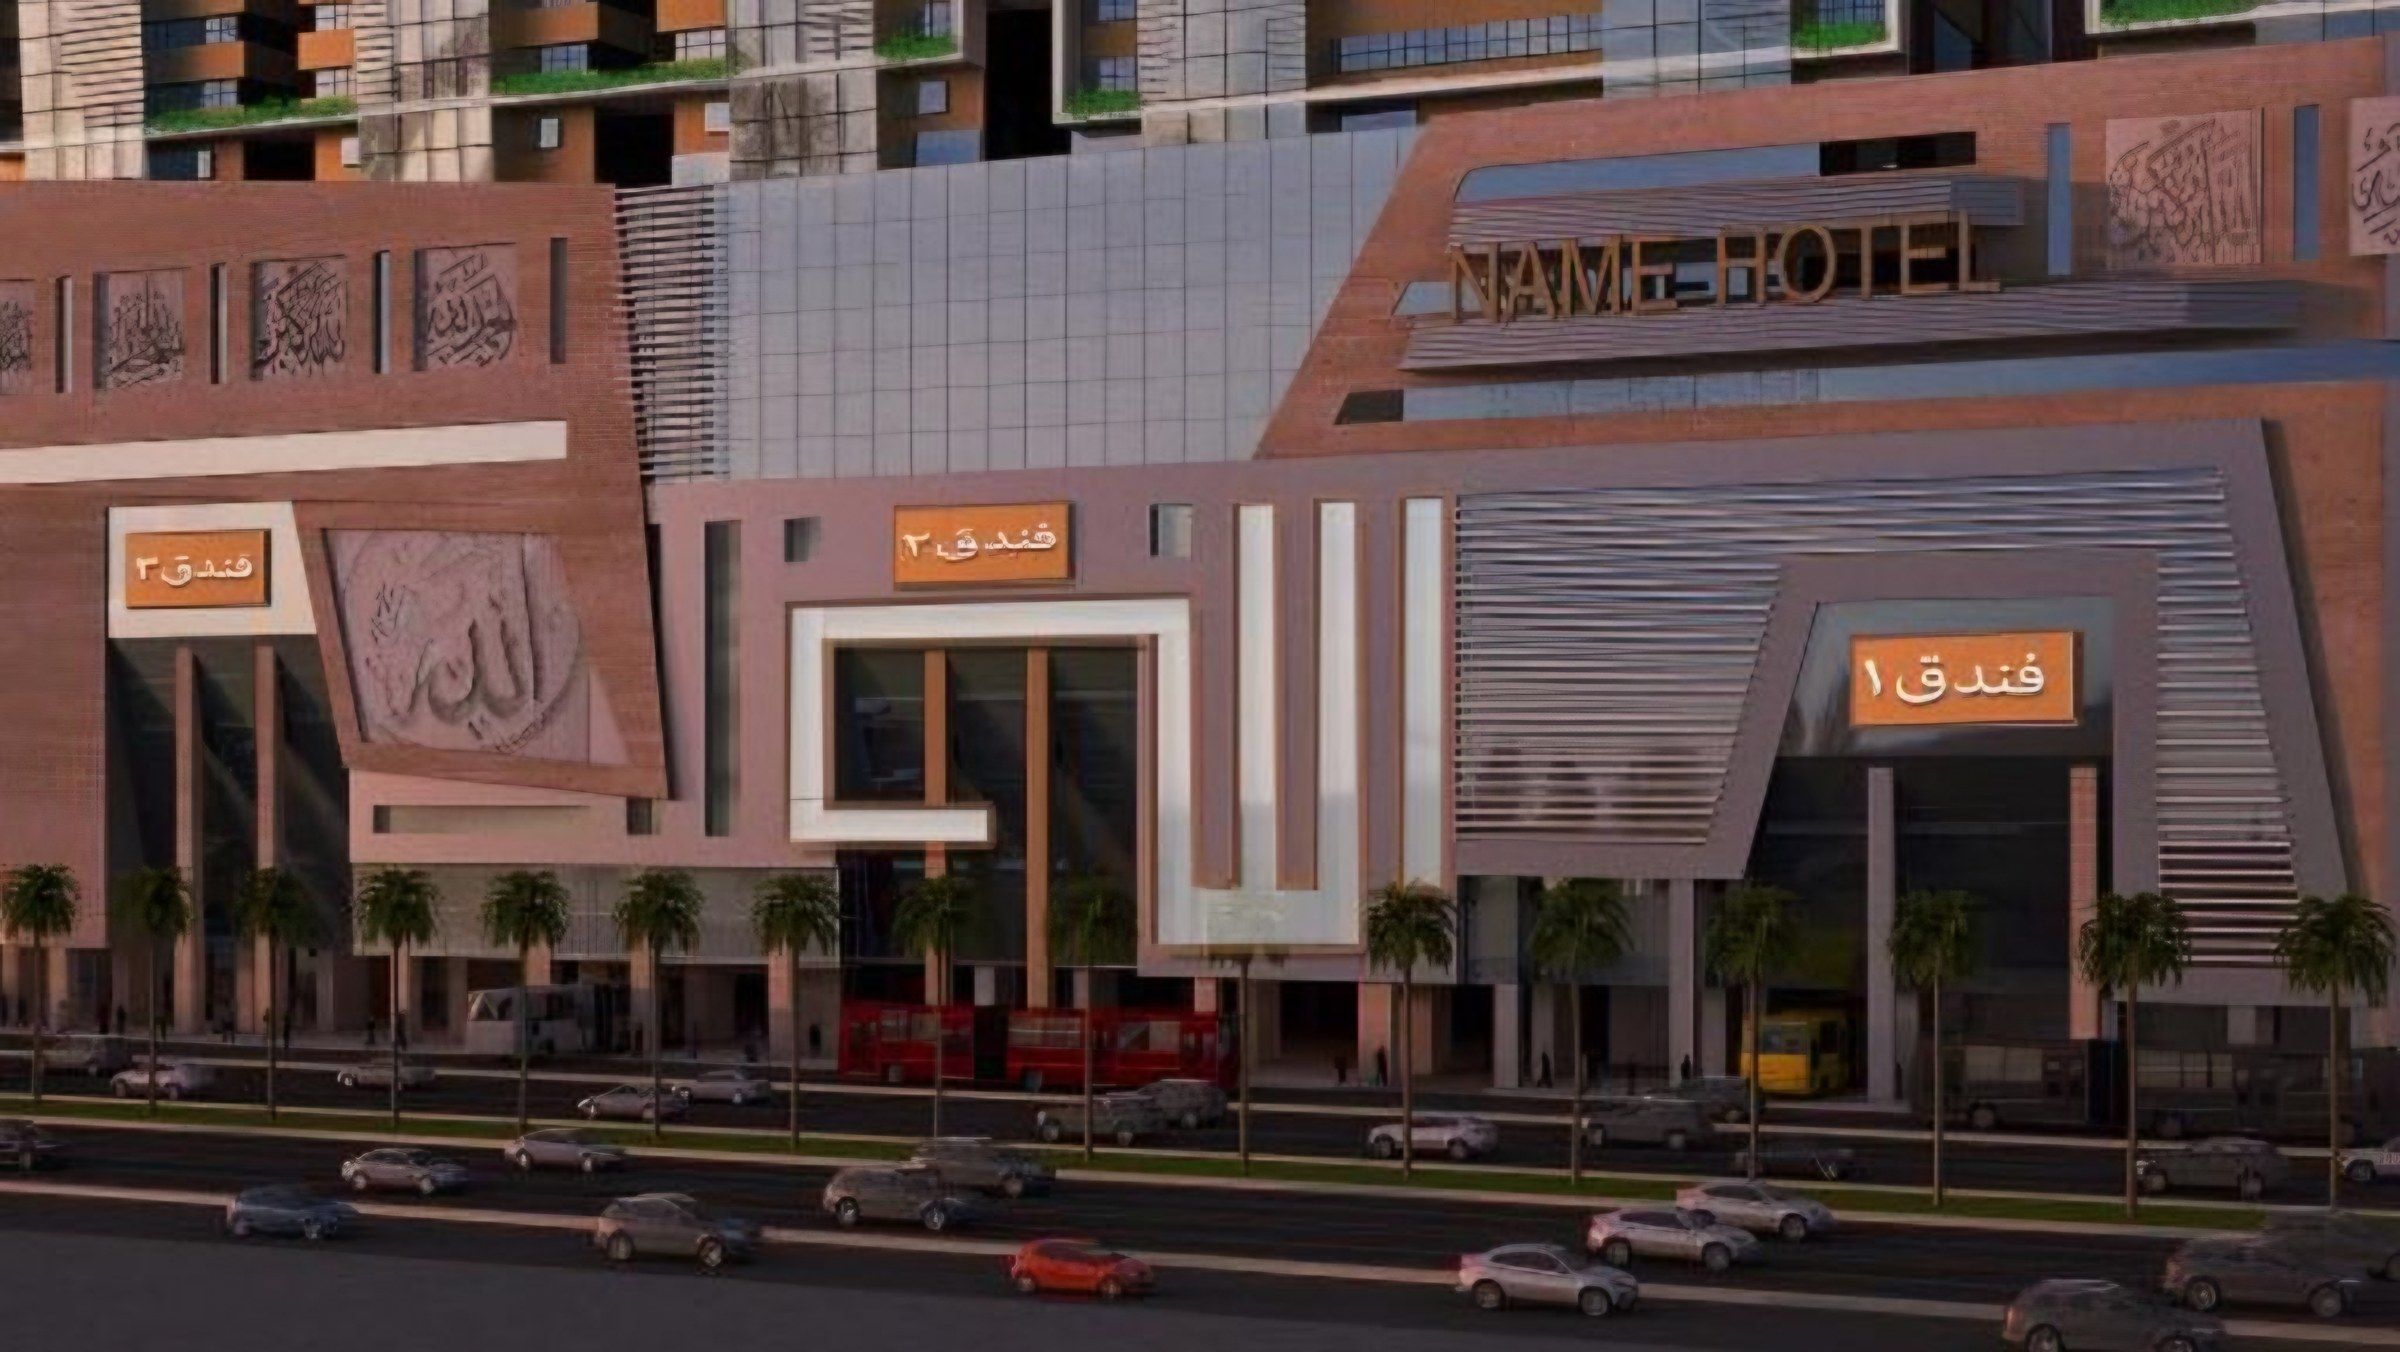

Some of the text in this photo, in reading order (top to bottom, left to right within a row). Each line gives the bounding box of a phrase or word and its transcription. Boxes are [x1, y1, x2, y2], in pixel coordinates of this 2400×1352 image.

[1449, 209, 2001, 326] NAME HOTEL
[1895, 652, 2045, 704] فندق
